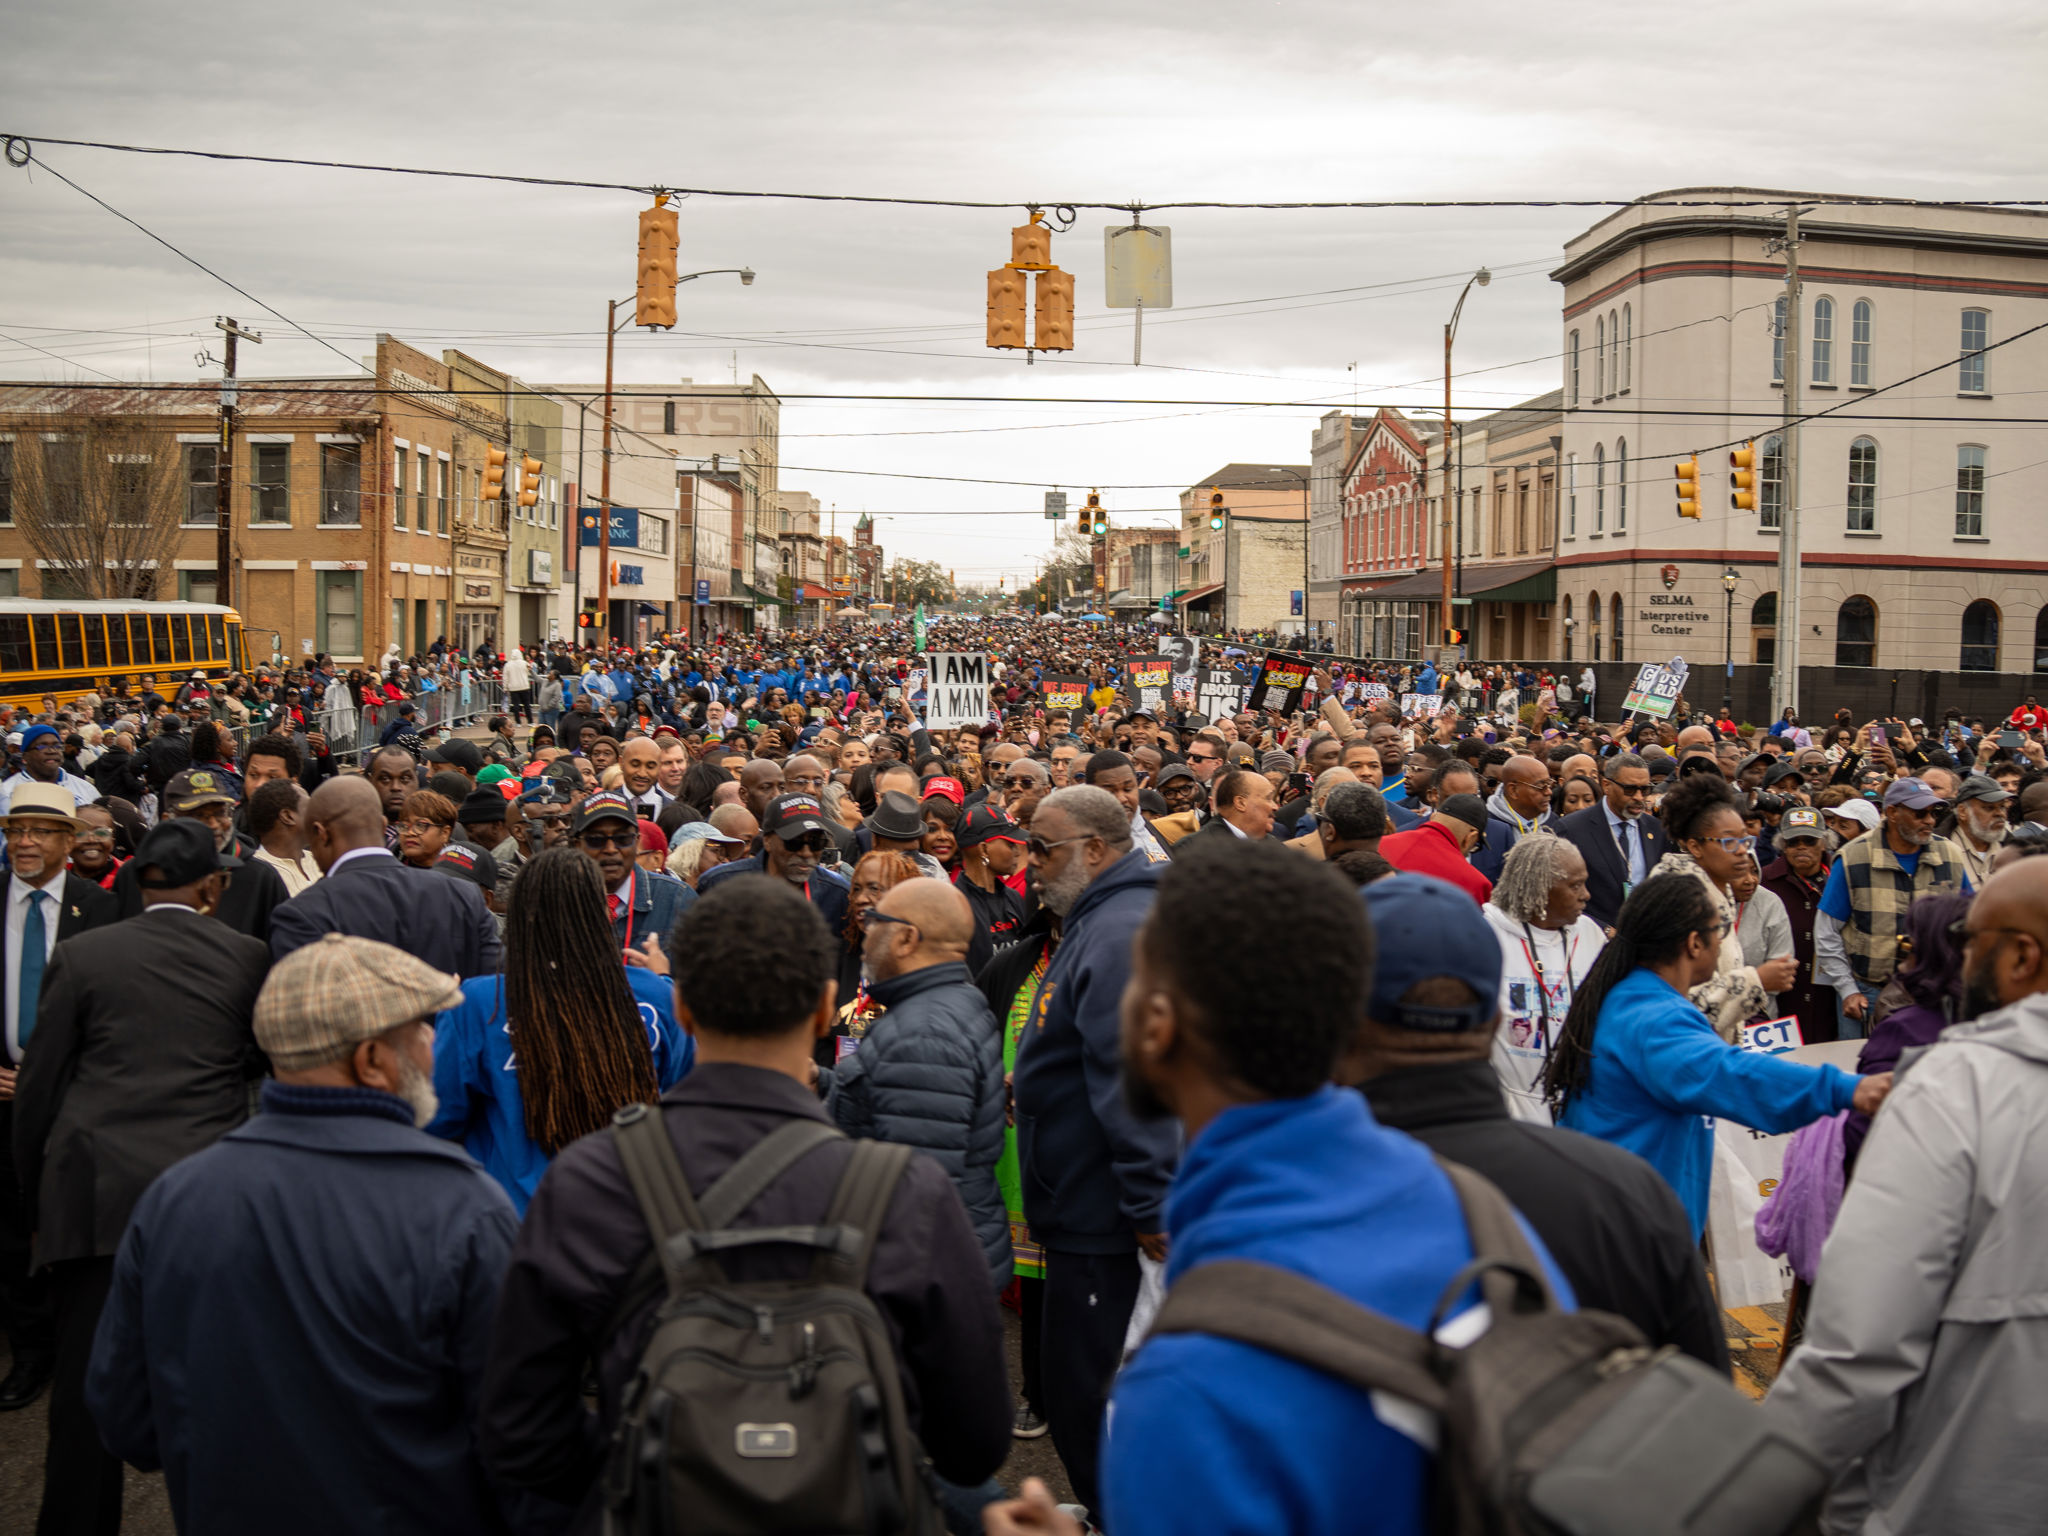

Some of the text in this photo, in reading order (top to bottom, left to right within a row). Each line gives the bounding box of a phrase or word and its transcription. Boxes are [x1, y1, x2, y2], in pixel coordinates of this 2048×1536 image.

[1650, 595, 1694, 606] SELMA
[1640, 610, 1710, 623] Interpretive
[1651, 624, 1693, 635] Center
[930, 656, 983, 684] I AM
[1129, 661, 1172, 674] WE FIGHT
[1265, 659, 1311, 678] WE FIGHT
[1210, 671, 1232, 684] IT'S
[1642, 668, 1682, 687] GD'S
[1042, 681, 1089, 696] WE FIGHT
[1200, 683, 1241, 697] ABOUT
[1636, 679, 1678, 698] WRLD
[931, 688, 983, 717] A MAN
[1199, 695, 1239, 723] US
